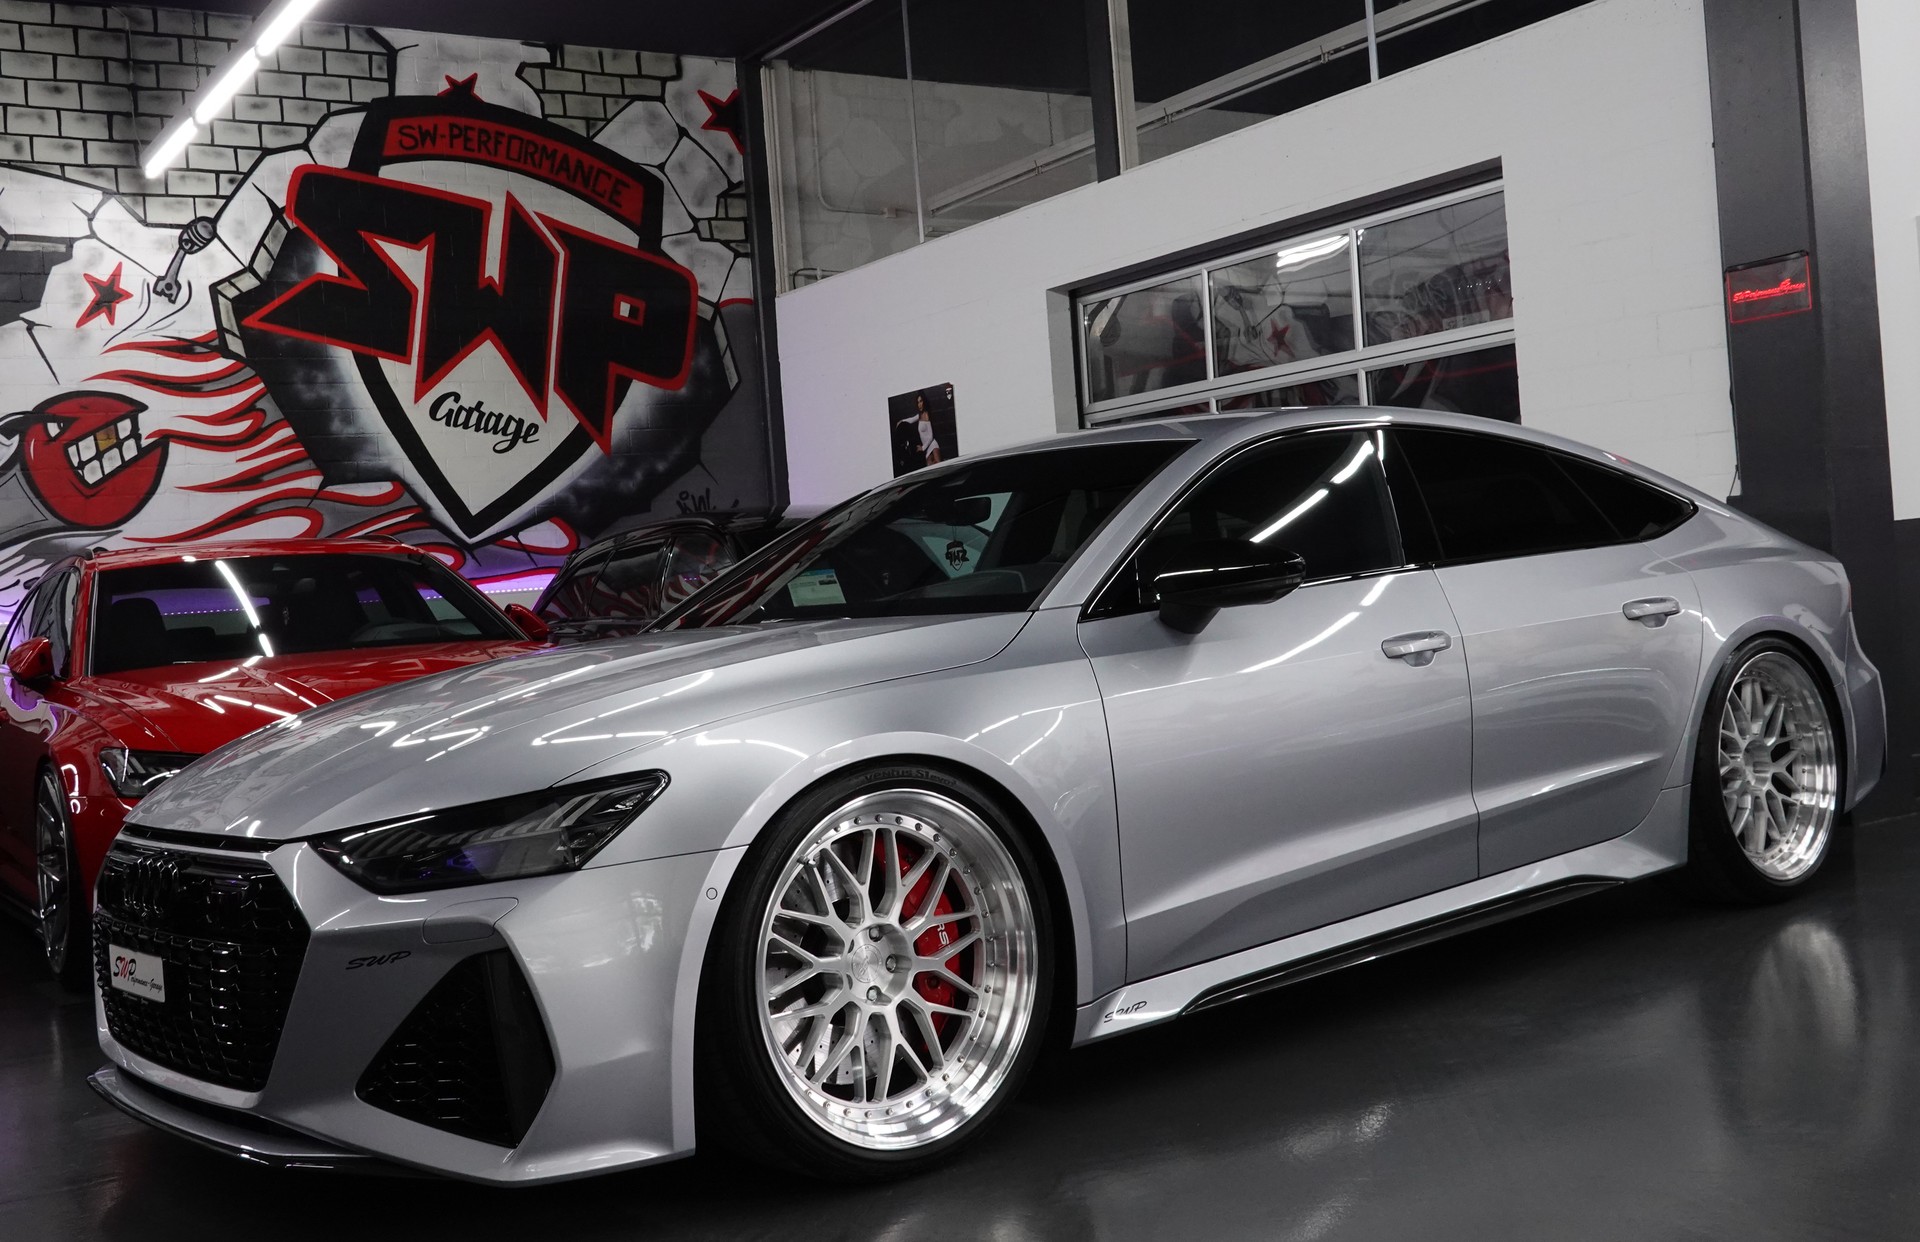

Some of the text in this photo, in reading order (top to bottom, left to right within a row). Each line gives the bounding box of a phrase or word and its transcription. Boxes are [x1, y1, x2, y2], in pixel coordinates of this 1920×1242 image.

[398, 124, 631, 209] SW-PERFORMANCE
[241, 163, 699, 458] SWP
[429, 391, 540, 454] Garage
[113, 956, 137, 982] SWP
[345, 951, 411, 970] SWP
